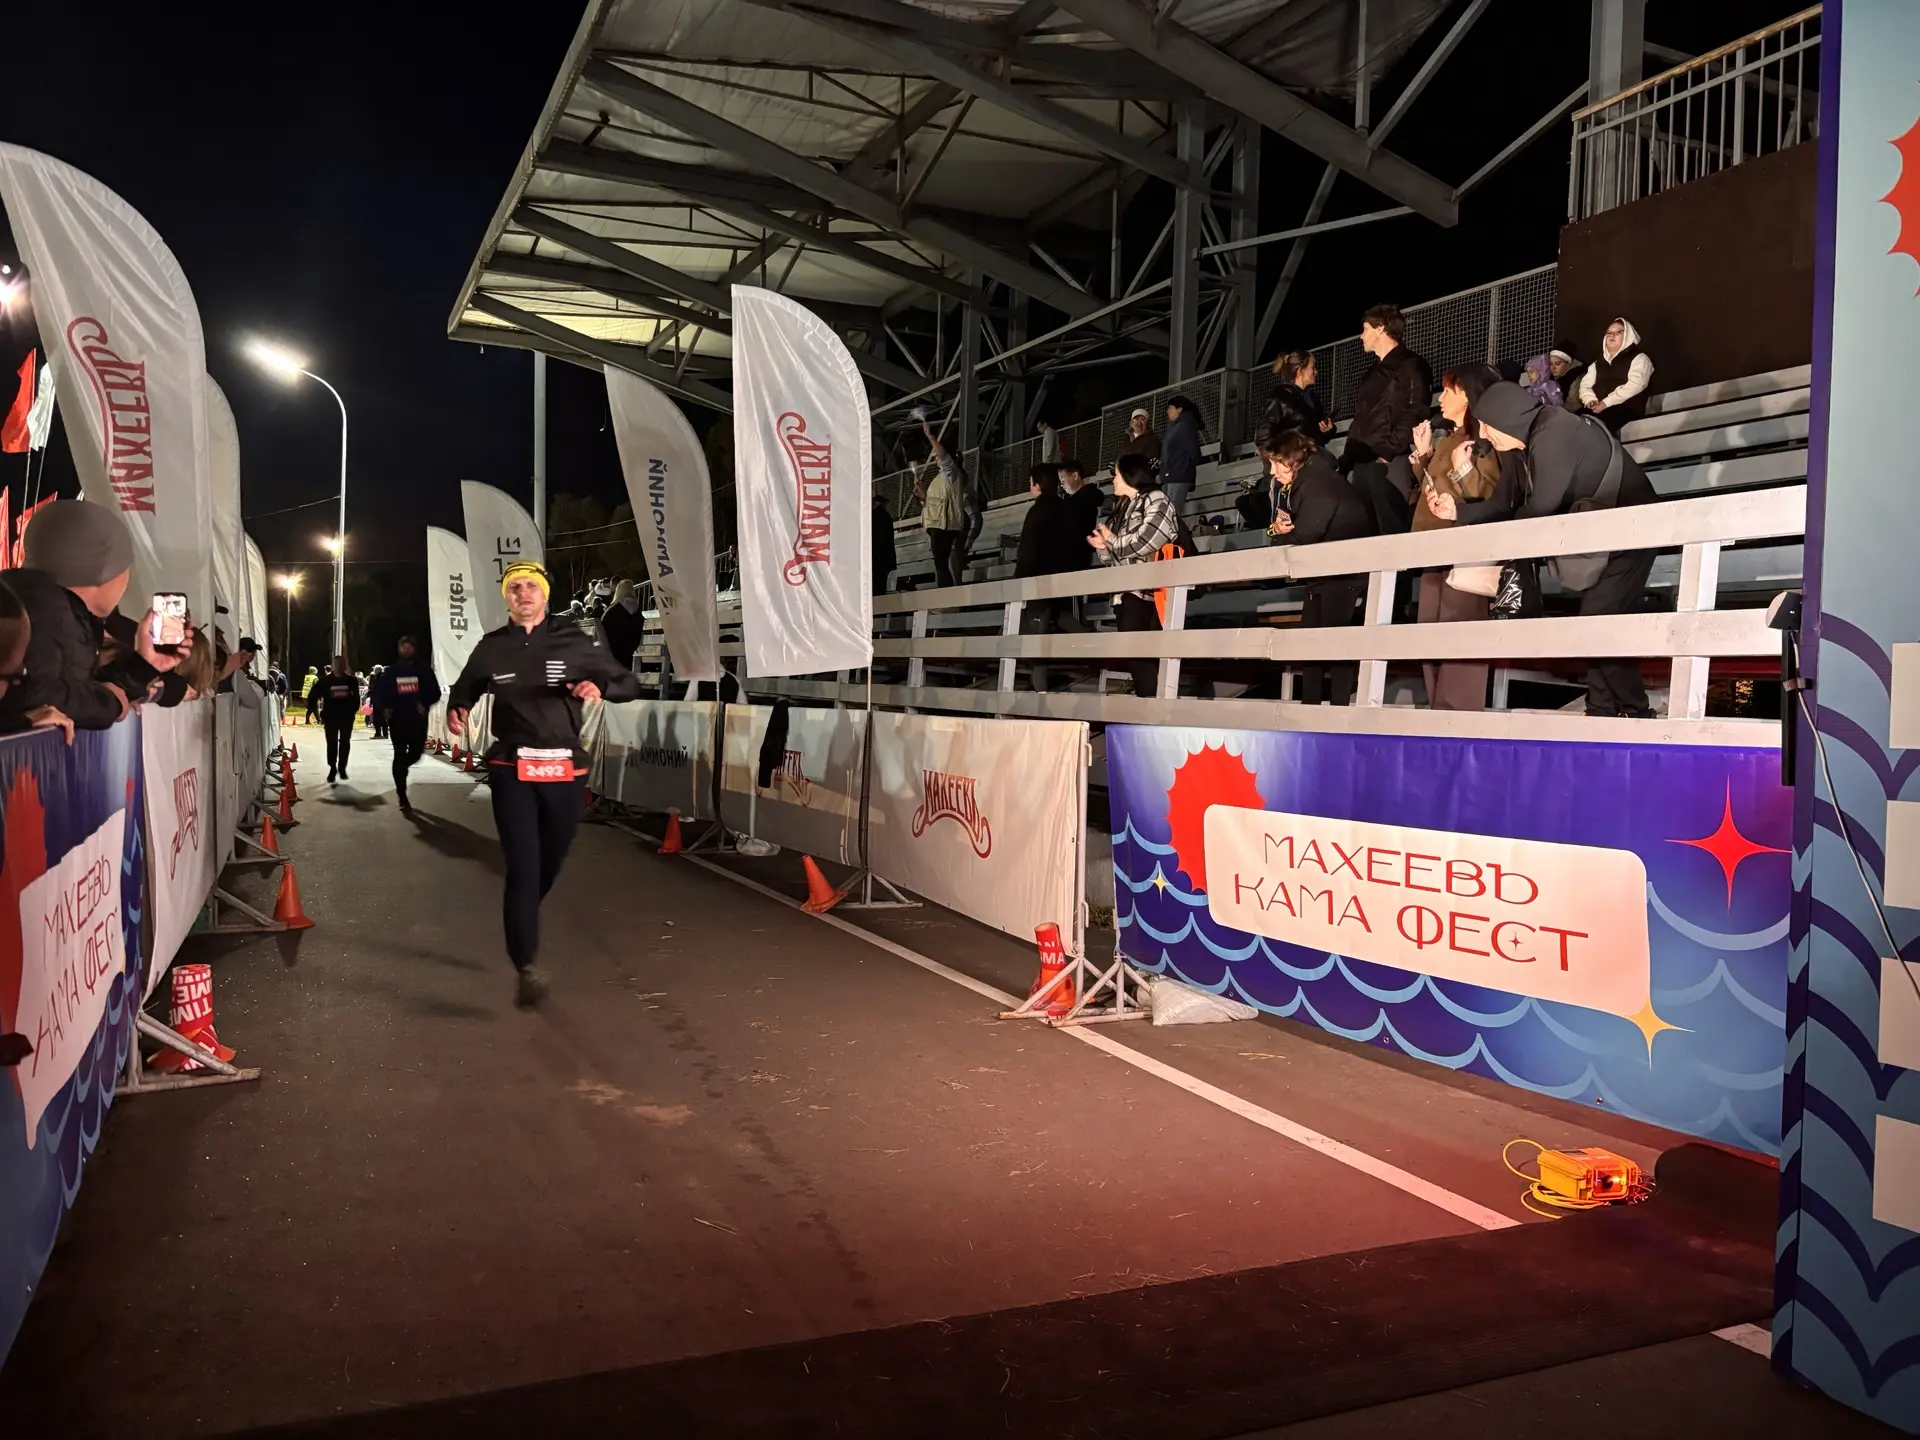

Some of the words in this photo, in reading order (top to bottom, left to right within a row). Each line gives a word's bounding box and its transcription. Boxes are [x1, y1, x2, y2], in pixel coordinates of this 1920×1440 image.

[1264, 832, 1539, 905] МАХЕЕВЪ
[1234, 872, 1373, 934] КАМА
[1396, 904, 1589, 972] ФЕСТ
